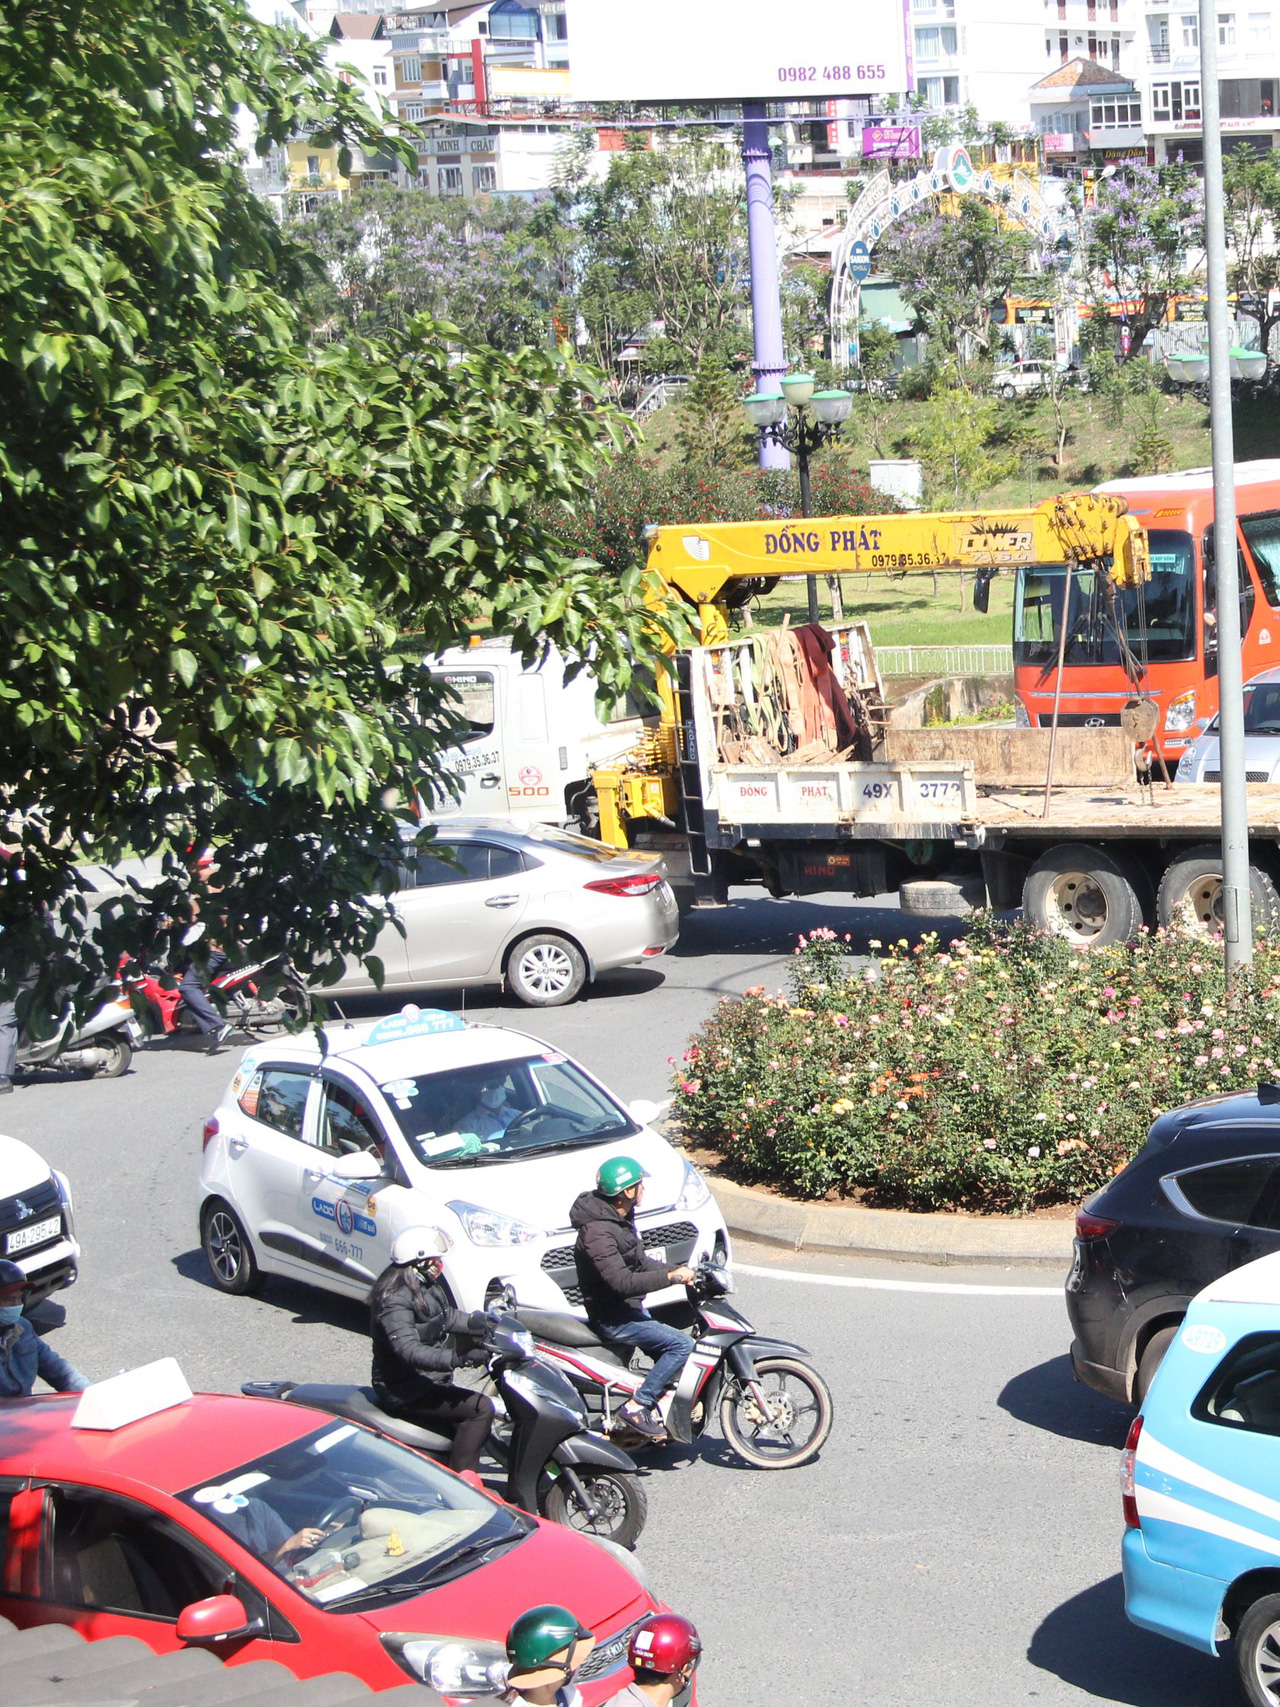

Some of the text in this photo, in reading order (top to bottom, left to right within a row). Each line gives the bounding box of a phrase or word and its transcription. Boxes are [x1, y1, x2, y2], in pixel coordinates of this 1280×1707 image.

[778, 65, 885, 82] 0982 488 655
[437, 140, 460, 152] MINH
[765, 525, 882, 554] ĐỒNG PHÁT
[686, 721, 696, 760] TADANO
[508, 787, 549, 796] 500
[862, 783, 894, 799] 49X
[804, 866, 836, 876] HINO
[313, 1201, 334, 1217] LADO
[334, 1239, 363, 1260] 666-777
[610, 1642, 625, 1657] KIA
